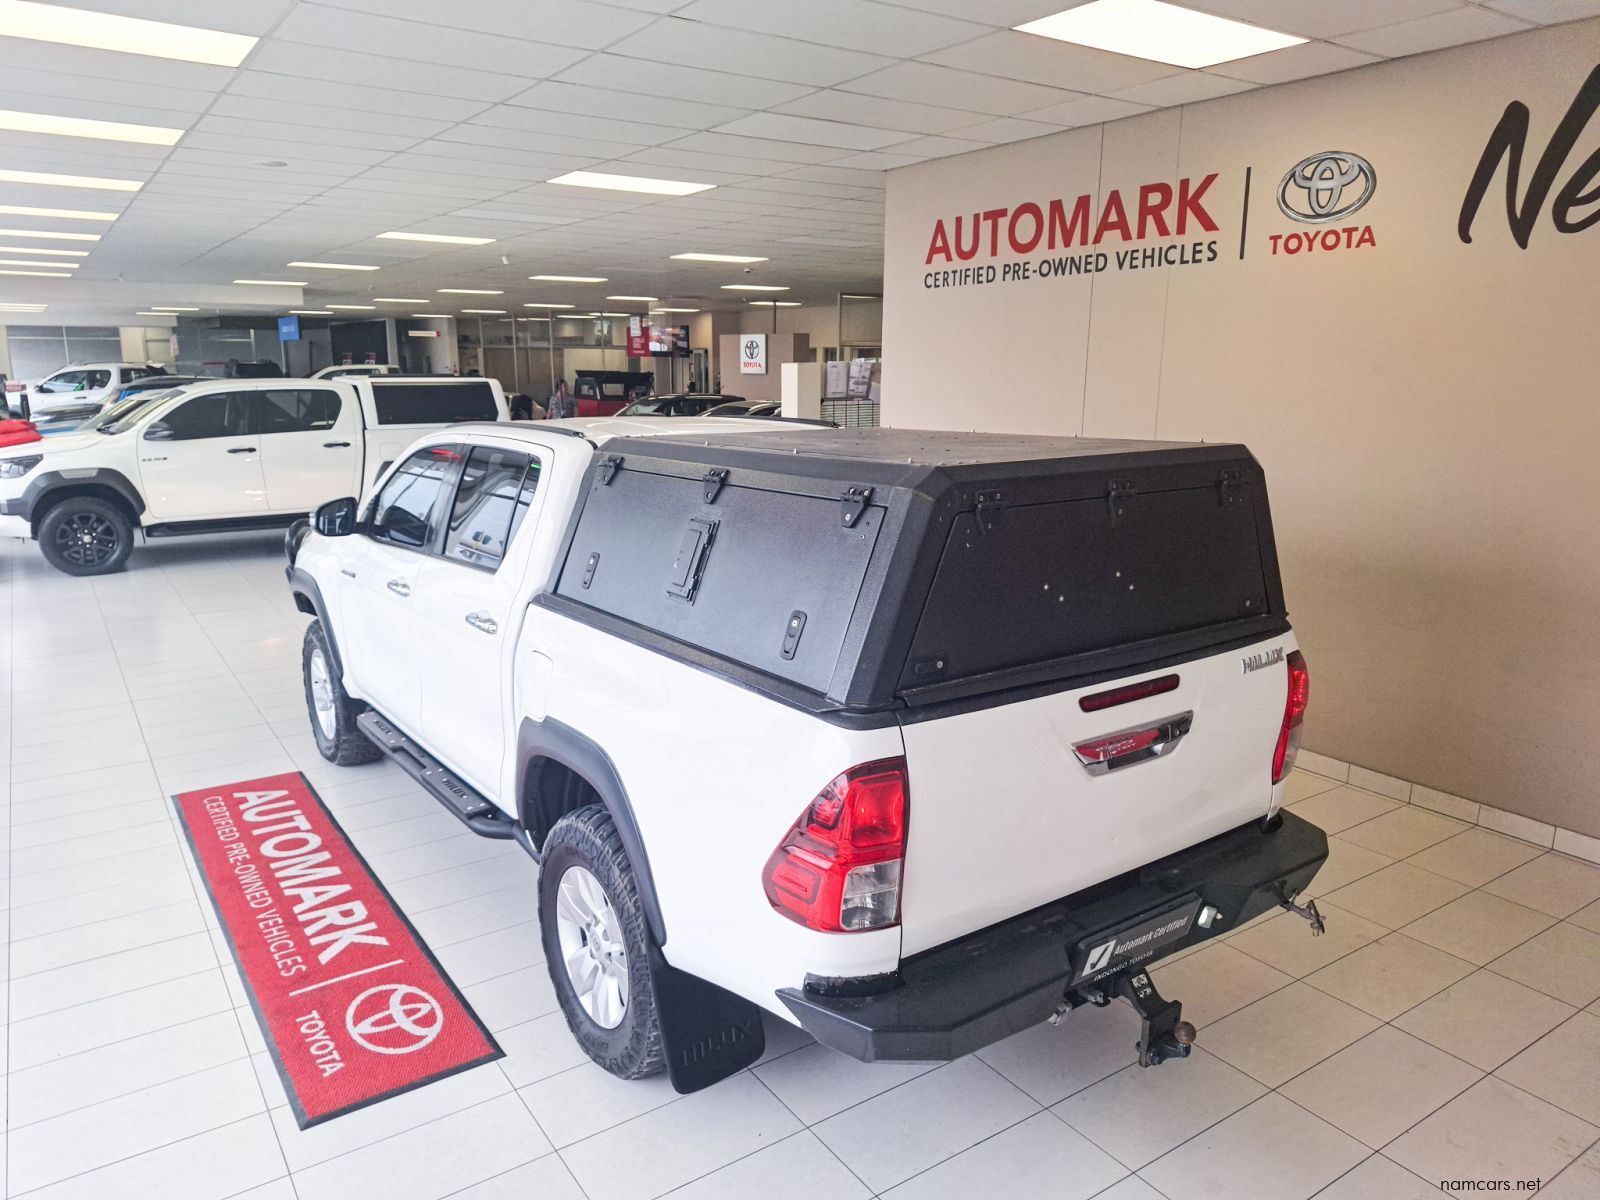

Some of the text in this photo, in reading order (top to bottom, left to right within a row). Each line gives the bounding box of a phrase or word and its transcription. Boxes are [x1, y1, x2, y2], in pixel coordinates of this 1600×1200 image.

[925, 172, 1219, 265] AUTOMARK
[1269, 225, 1377, 255] TOYOTA
[924, 240, 1218, 289] CERTIFIED PRE-OWNED VEHICLES
[743, 361, 762, 369] TOYOTA
[442, 779, 466, 799] HILUX
[203, 795, 307, 978] CERTIFIED PRE-OWNED VEHICLES
[233, 789, 390, 966] AUTOMARK
[1113, 915, 1189, 956] Automark Certified
[1128, 950, 1154, 966] TOYOTA
[295, 1010, 346, 1078] TOYOTA
